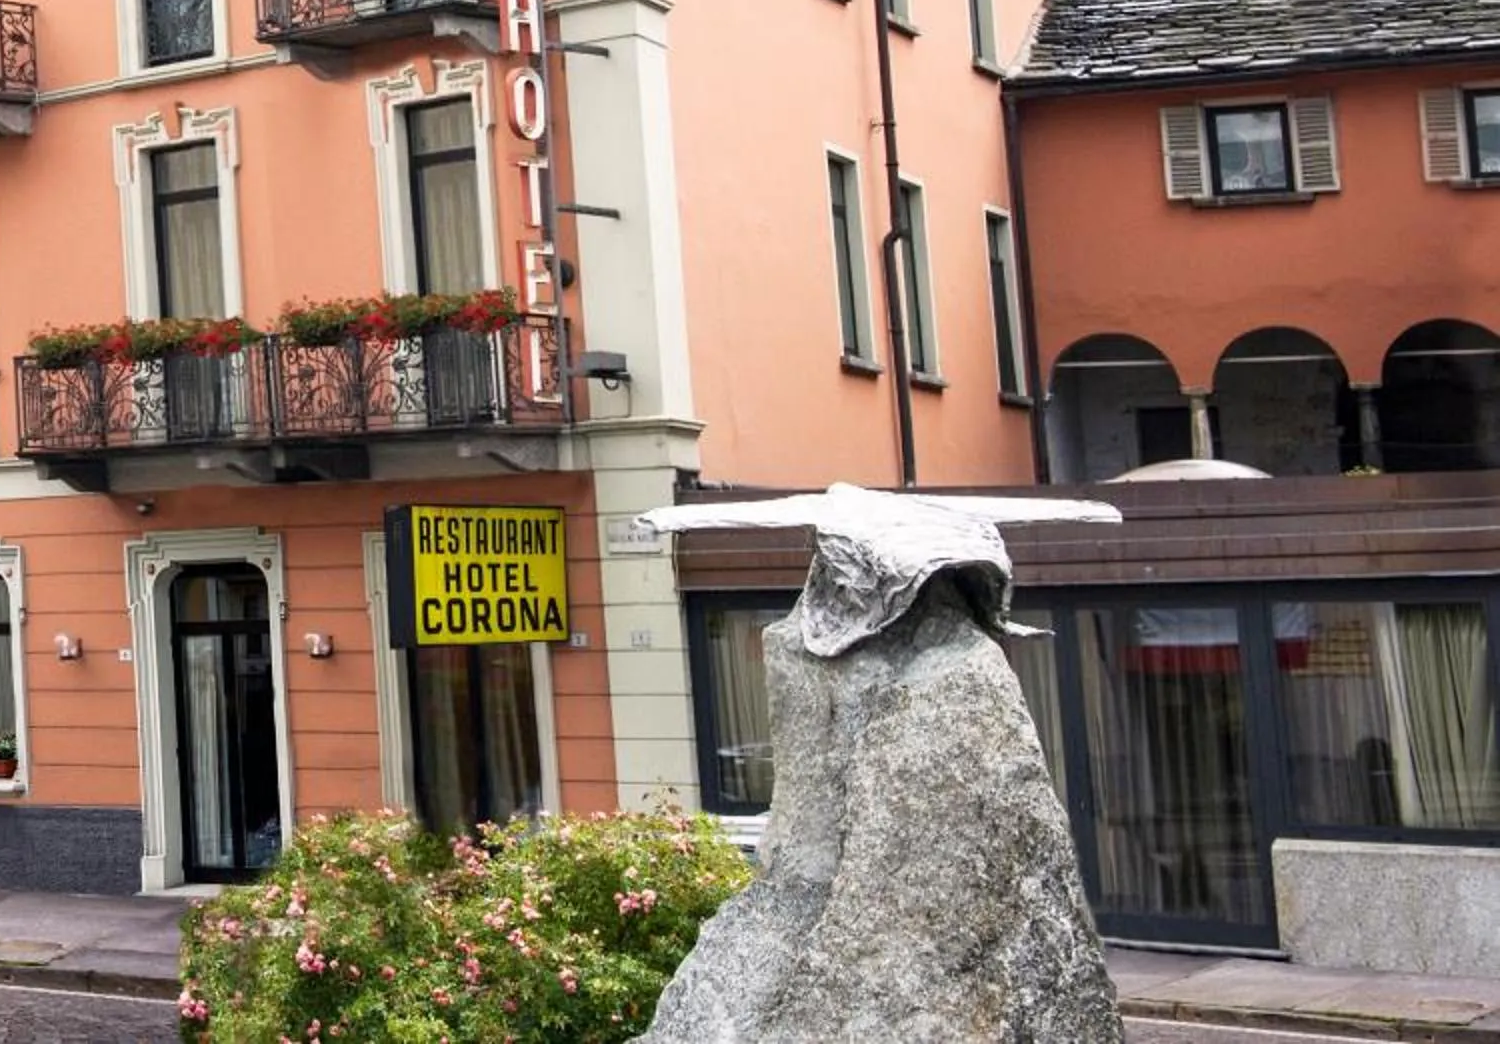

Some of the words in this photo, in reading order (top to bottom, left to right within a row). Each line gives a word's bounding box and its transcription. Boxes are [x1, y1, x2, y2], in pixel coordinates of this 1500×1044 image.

[418, 516, 560, 556] RESTAURANT
[443, 563, 539, 593] HOTEL
[421, 598, 564, 635] CORONA
